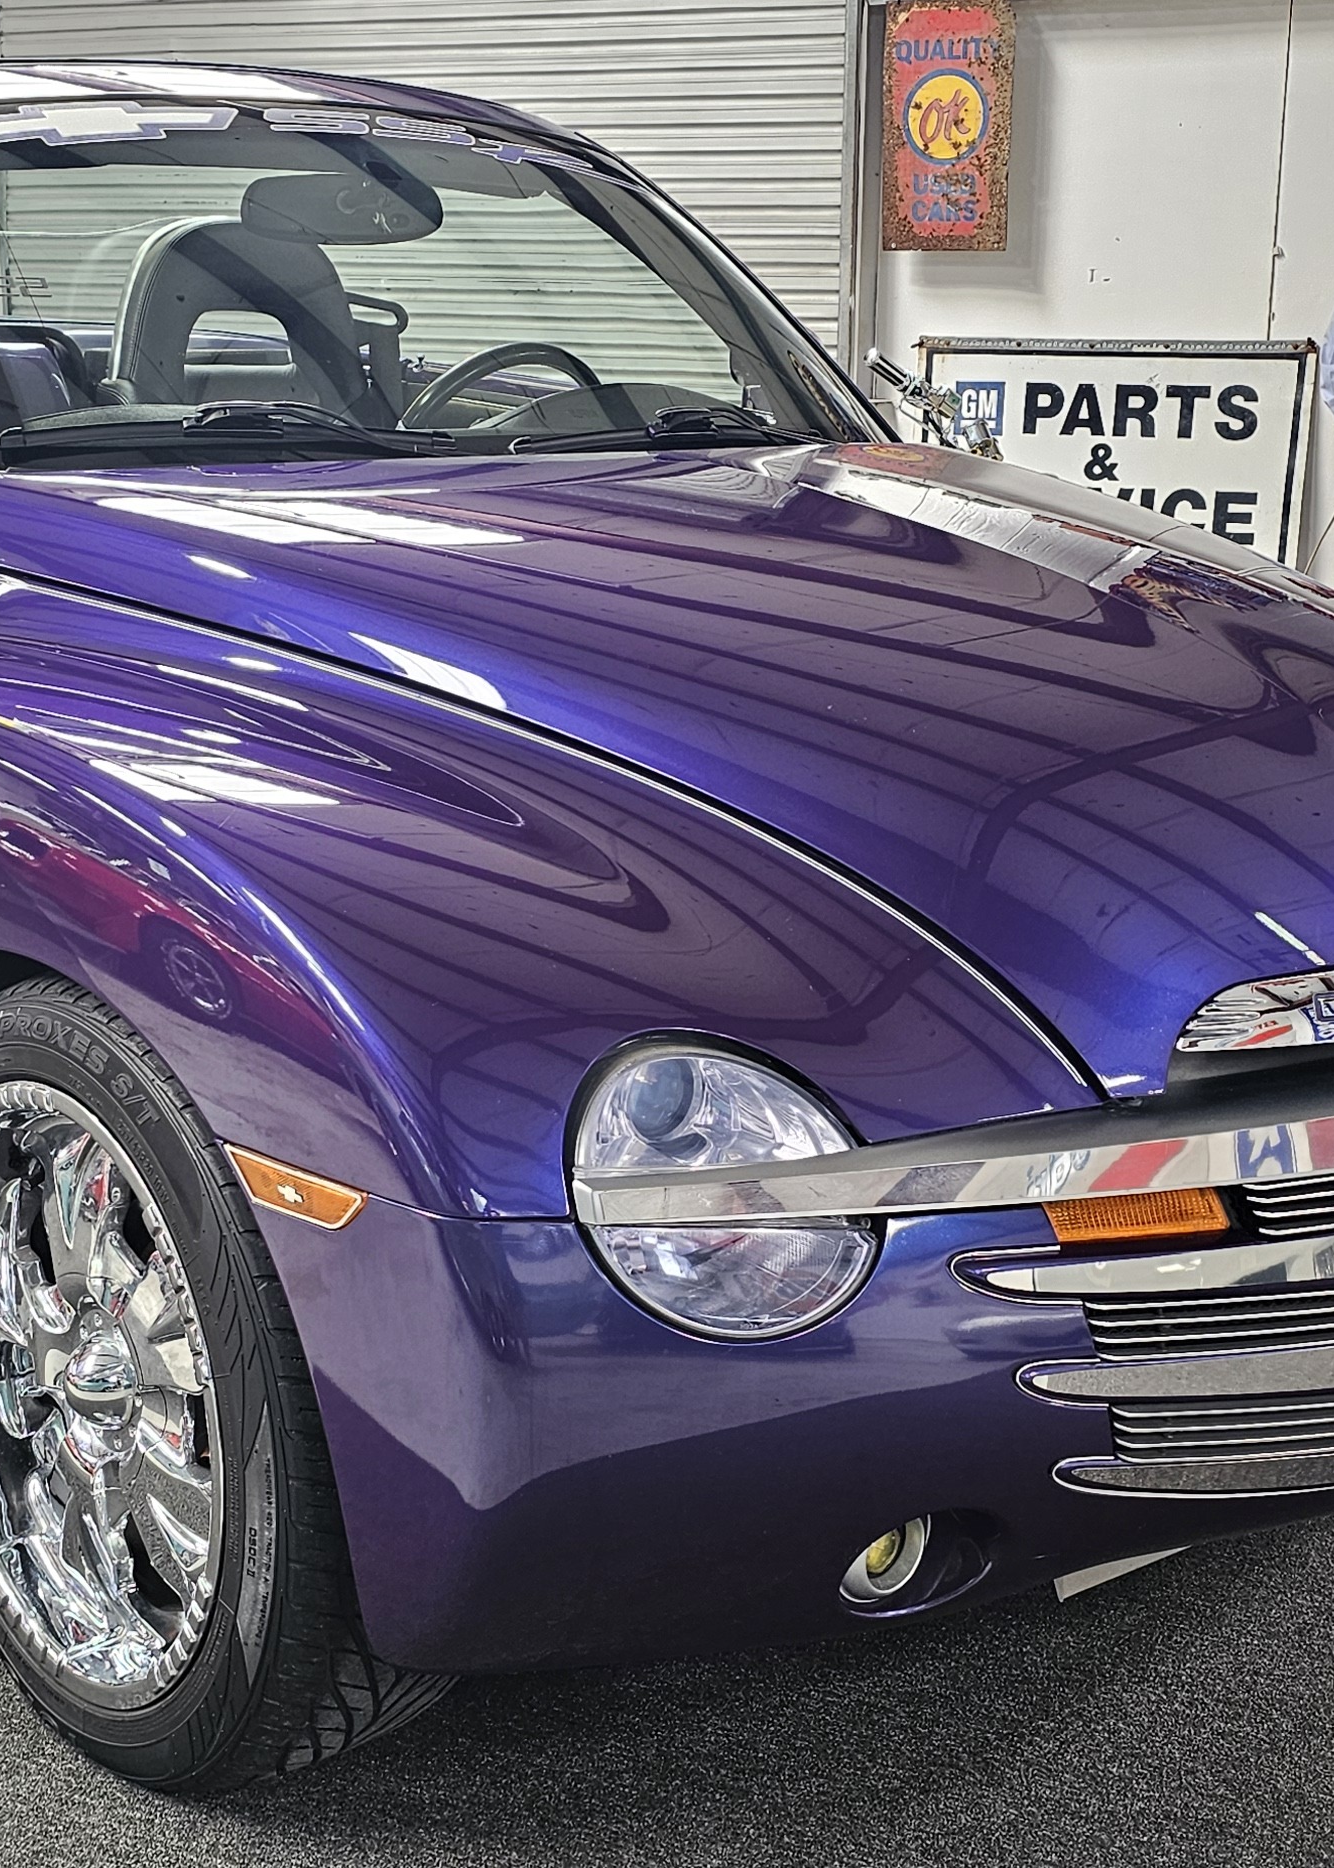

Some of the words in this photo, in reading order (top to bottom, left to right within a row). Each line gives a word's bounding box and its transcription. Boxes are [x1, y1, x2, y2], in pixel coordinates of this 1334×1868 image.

[895, 36, 1001, 64] QUALITY
[919, 89, 971, 144] OK
[913, 173, 977, 195] USED
[912, 200, 978, 223] CARS
[961, 389, 998, 420] GM
[1022, 382, 1259, 440] PARTS
[1084, 443, 1119, 481] &
[110, 1073, 161, 1126] S/T
